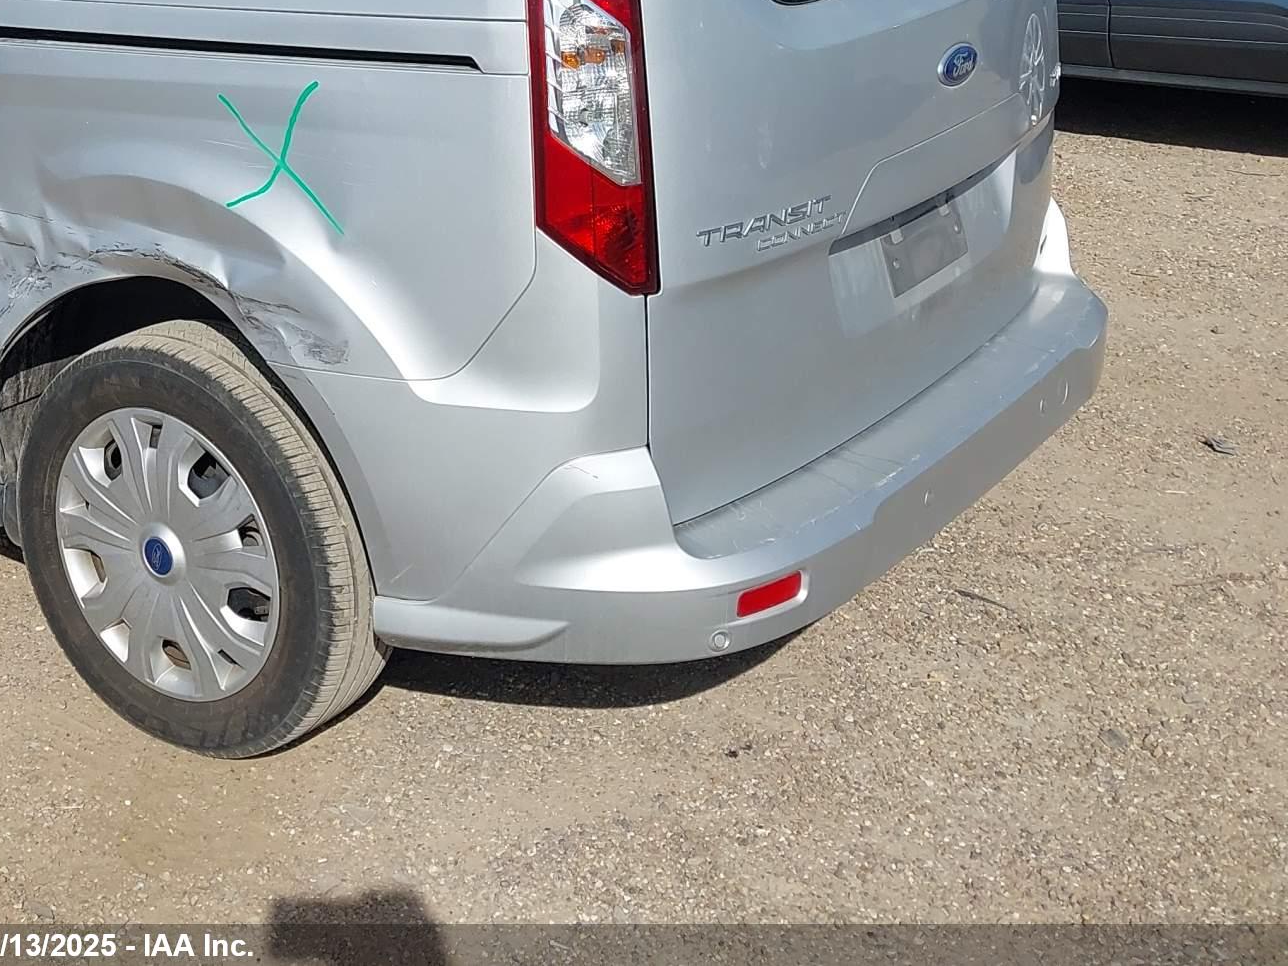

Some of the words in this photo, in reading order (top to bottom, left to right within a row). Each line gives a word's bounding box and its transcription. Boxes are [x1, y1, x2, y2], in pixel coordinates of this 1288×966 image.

[952, 51, 975, 78] Ford
[695, 194, 832, 247] TRANSIT
[756, 209, 847, 252] CONNECT
